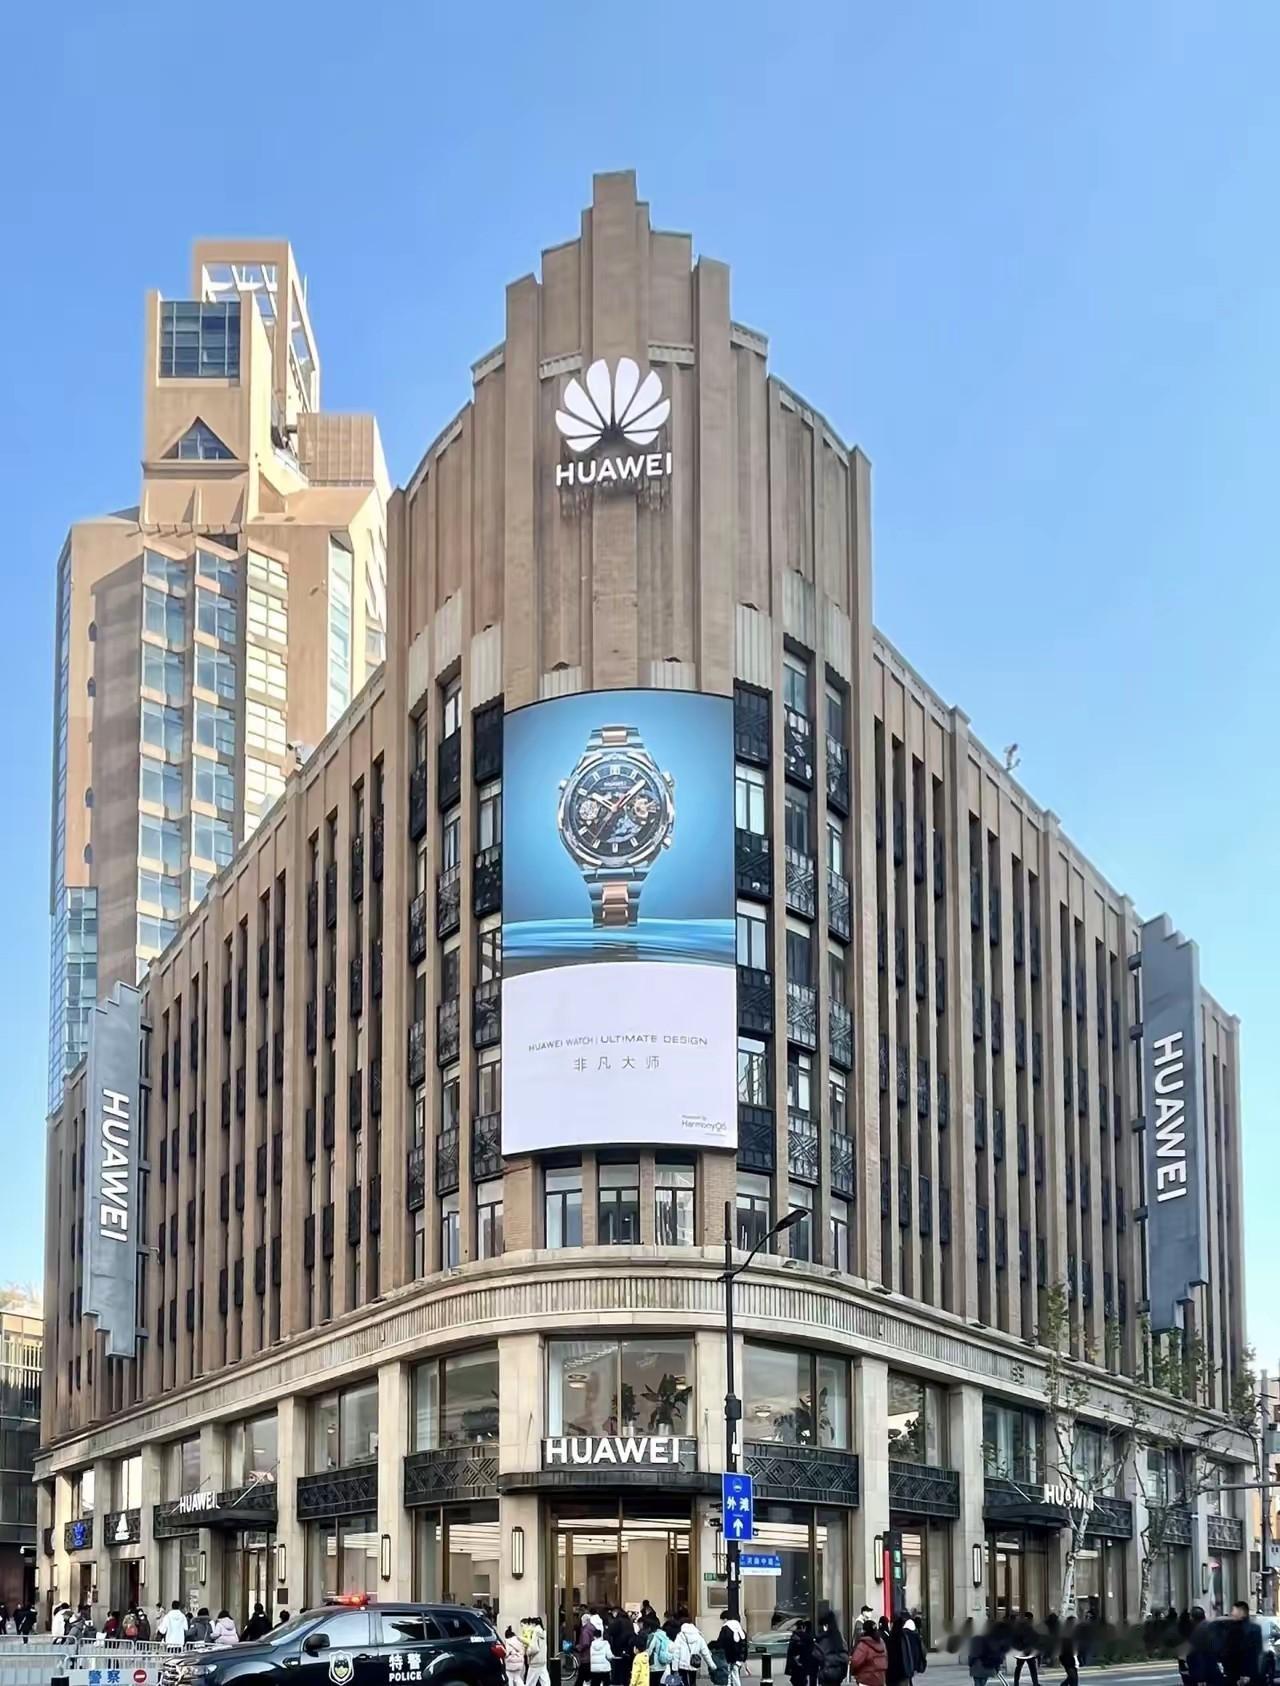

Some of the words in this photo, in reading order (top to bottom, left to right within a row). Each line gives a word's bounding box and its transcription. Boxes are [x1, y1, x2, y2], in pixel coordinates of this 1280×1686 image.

[556, 453, 672, 486] HUAWEI
[529, 1040, 563, 1052] HUAWEI
[566, 1037, 594, 1047] WATCH
[600, 1034, 657, 1044] ULTIMATE
[663, 1035, 708, 1046] DESIGN
[574, 1056, 660, 1072] 非凡大师
[1153, 1031, 1187, 1202] HUAWEI
[100, 1088, 130, 1243] HUAWEI
[546, 1437, 680, 1463] HUAWEI
[180, 1491, 217, 1514] HUAWEI
[727, 1496, 750, 1512] 外滩
[389, 1653, 422, 1671] 特警
[89, 1670, 120, 1684] 警察
[389, 1671, 422, 1682] POLICE
